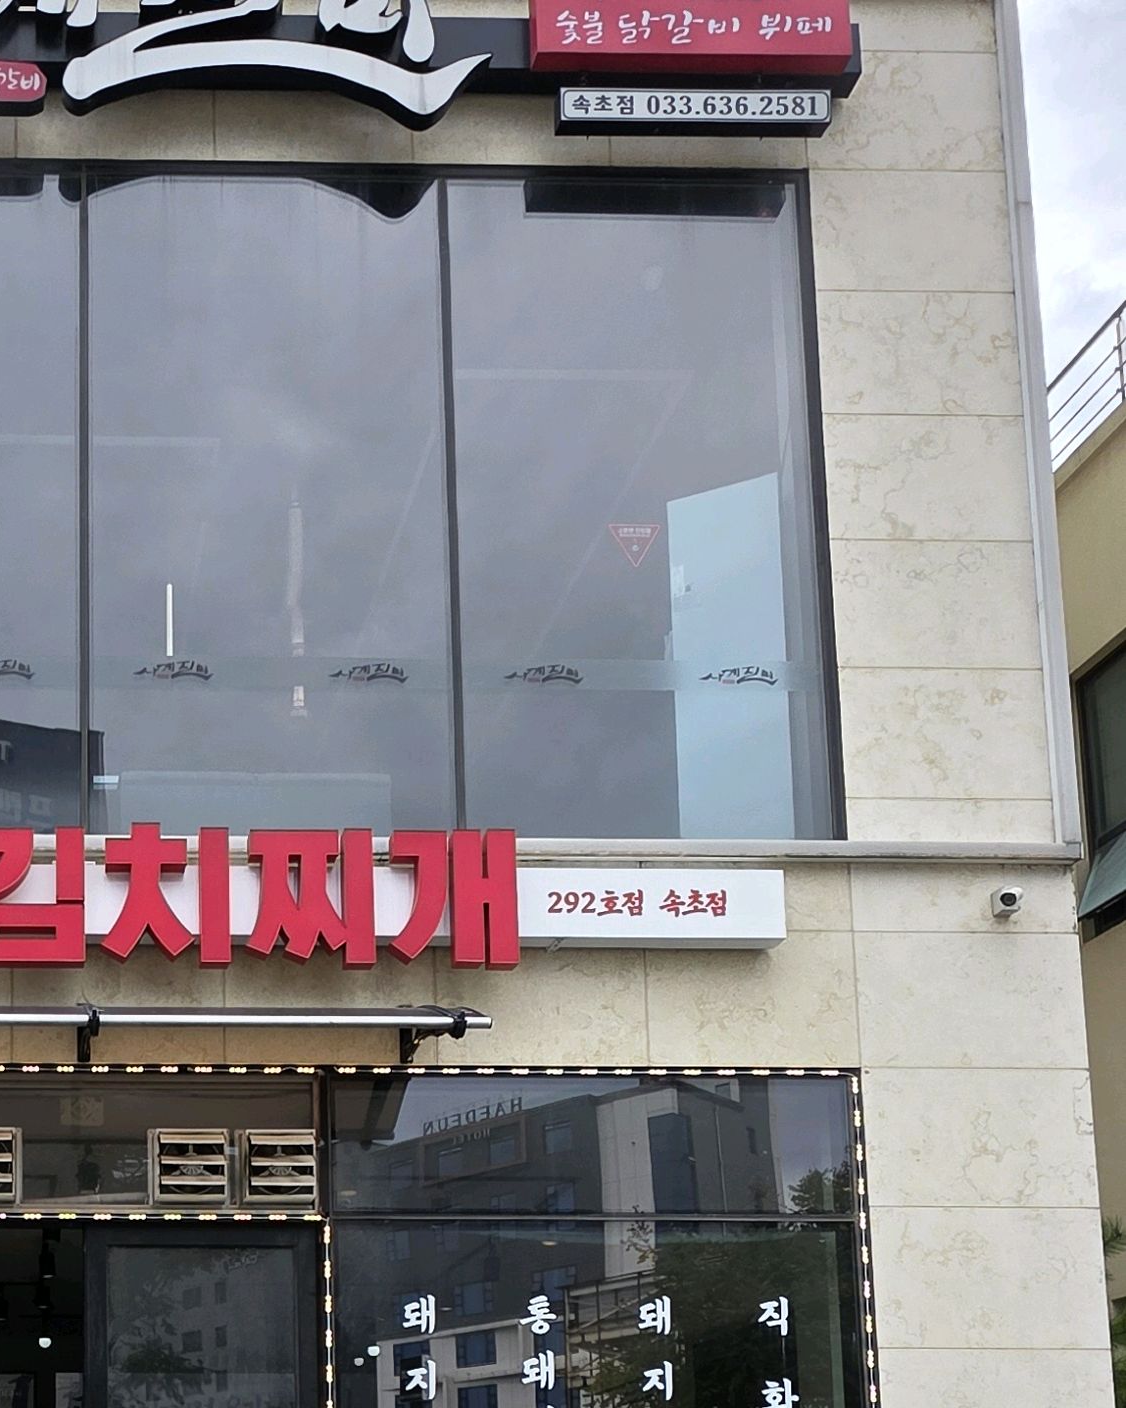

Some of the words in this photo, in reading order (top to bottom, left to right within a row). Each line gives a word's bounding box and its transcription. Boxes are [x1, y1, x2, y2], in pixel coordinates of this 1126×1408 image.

[555, 10, 603, 44] 숯불
[618, 10, 740, 44] 닭갈비
[758, 13, 832, 39] 뷔페
[571, 94, 635, 115] 속초점
[646, 95, 819, 116] 033.636.2581
[547, 888, 645, 917] 292호점
[659, 888, 728, 918] 속초점
